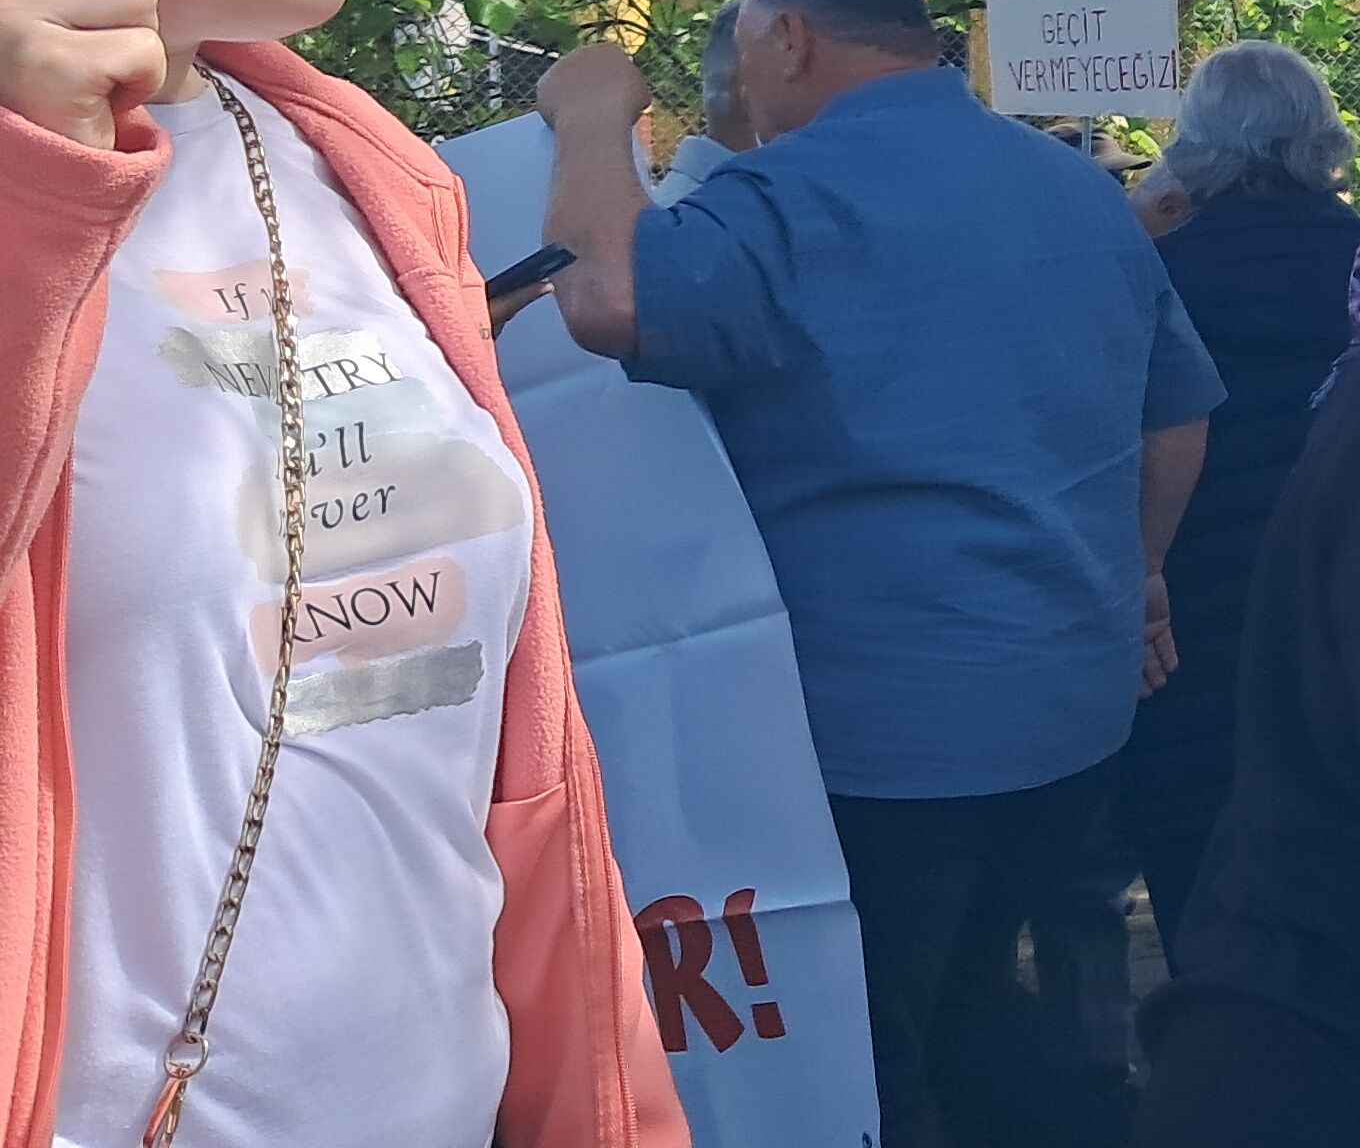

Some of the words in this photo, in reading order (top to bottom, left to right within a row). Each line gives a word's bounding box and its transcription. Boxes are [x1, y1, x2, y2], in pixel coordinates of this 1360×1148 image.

[1042, 7, 1107, 47] GEÇİT
[213, 283, 250, 320] If
[301, 353, 401, 397] TRY
